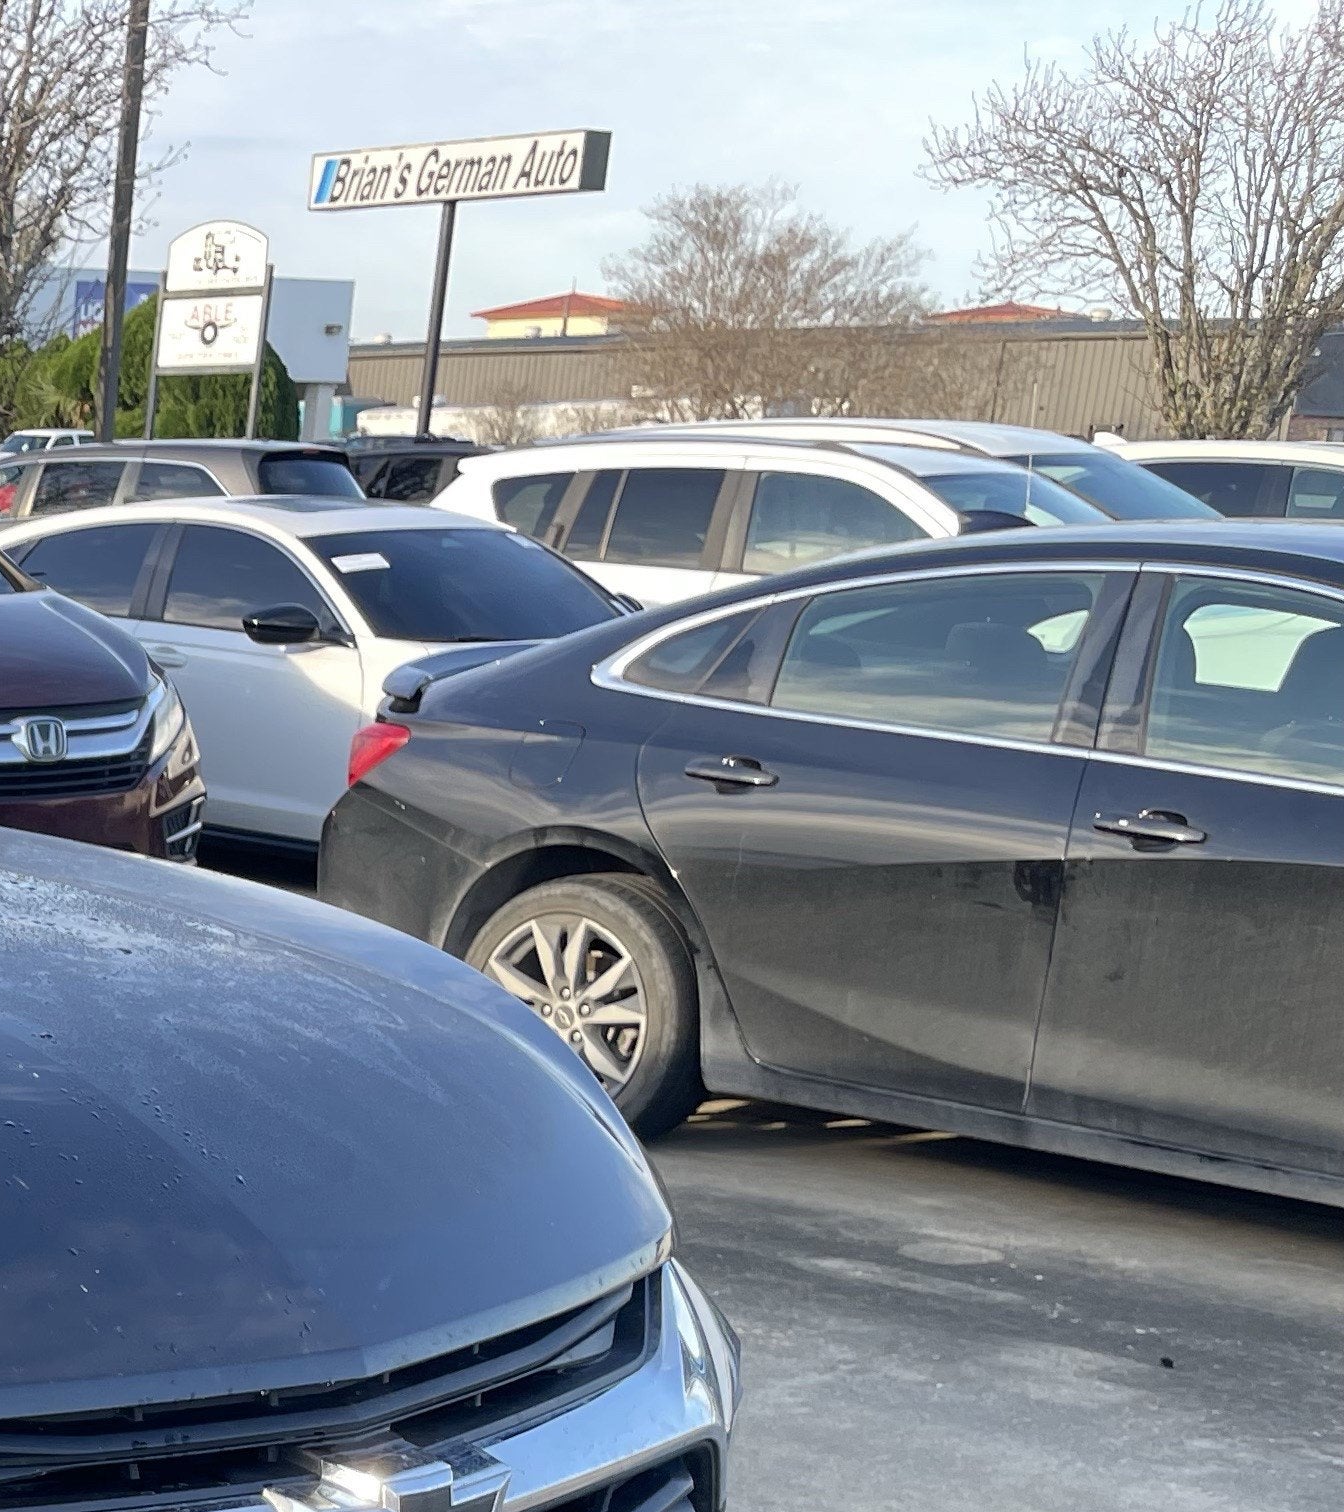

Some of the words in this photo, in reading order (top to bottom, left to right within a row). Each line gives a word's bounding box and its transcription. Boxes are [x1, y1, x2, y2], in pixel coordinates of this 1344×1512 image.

[329, 152, 412, 202] Brian's
[417, 148, 512, 197] German
[513, 140, 578, 188] Auto
[190, 303, 233, 322] ABLE
